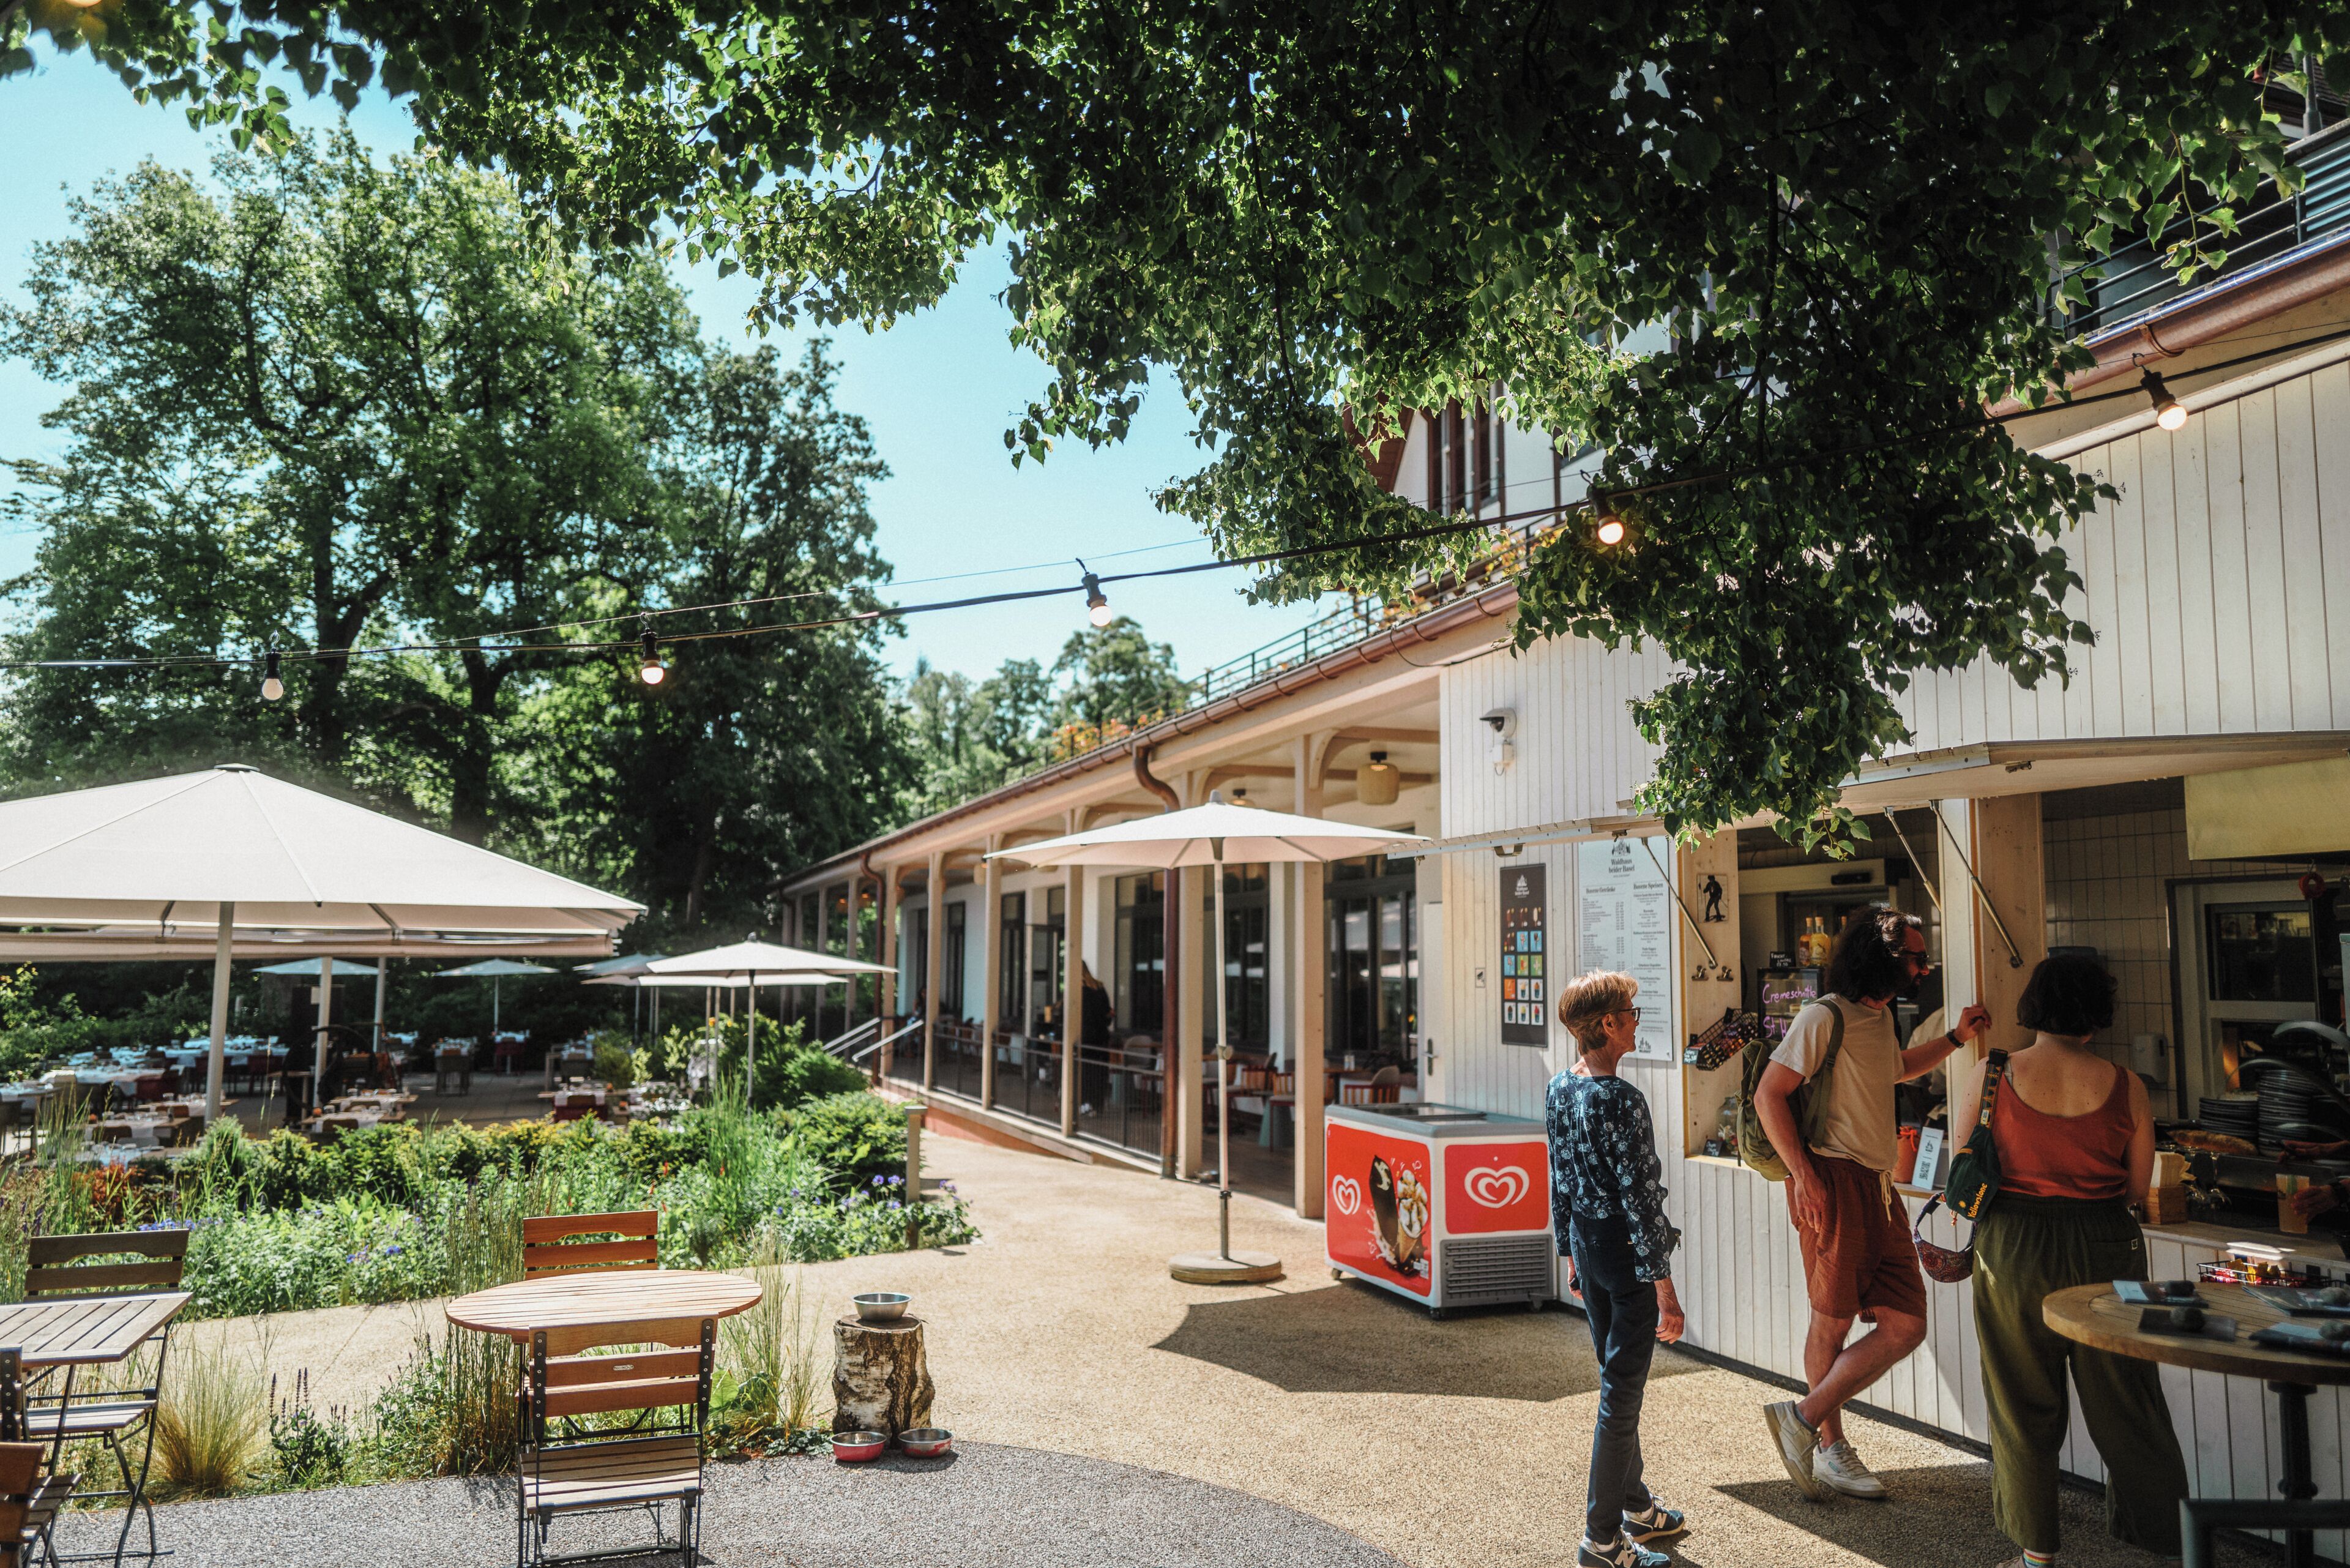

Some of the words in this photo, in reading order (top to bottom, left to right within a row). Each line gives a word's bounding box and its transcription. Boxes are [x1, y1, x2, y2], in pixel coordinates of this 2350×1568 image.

[1967, 1182, 1988, 1218] Yellowstone
[1654, 1512, 1668, 1528] N
[1614, 1549, 1637, 1568] N
